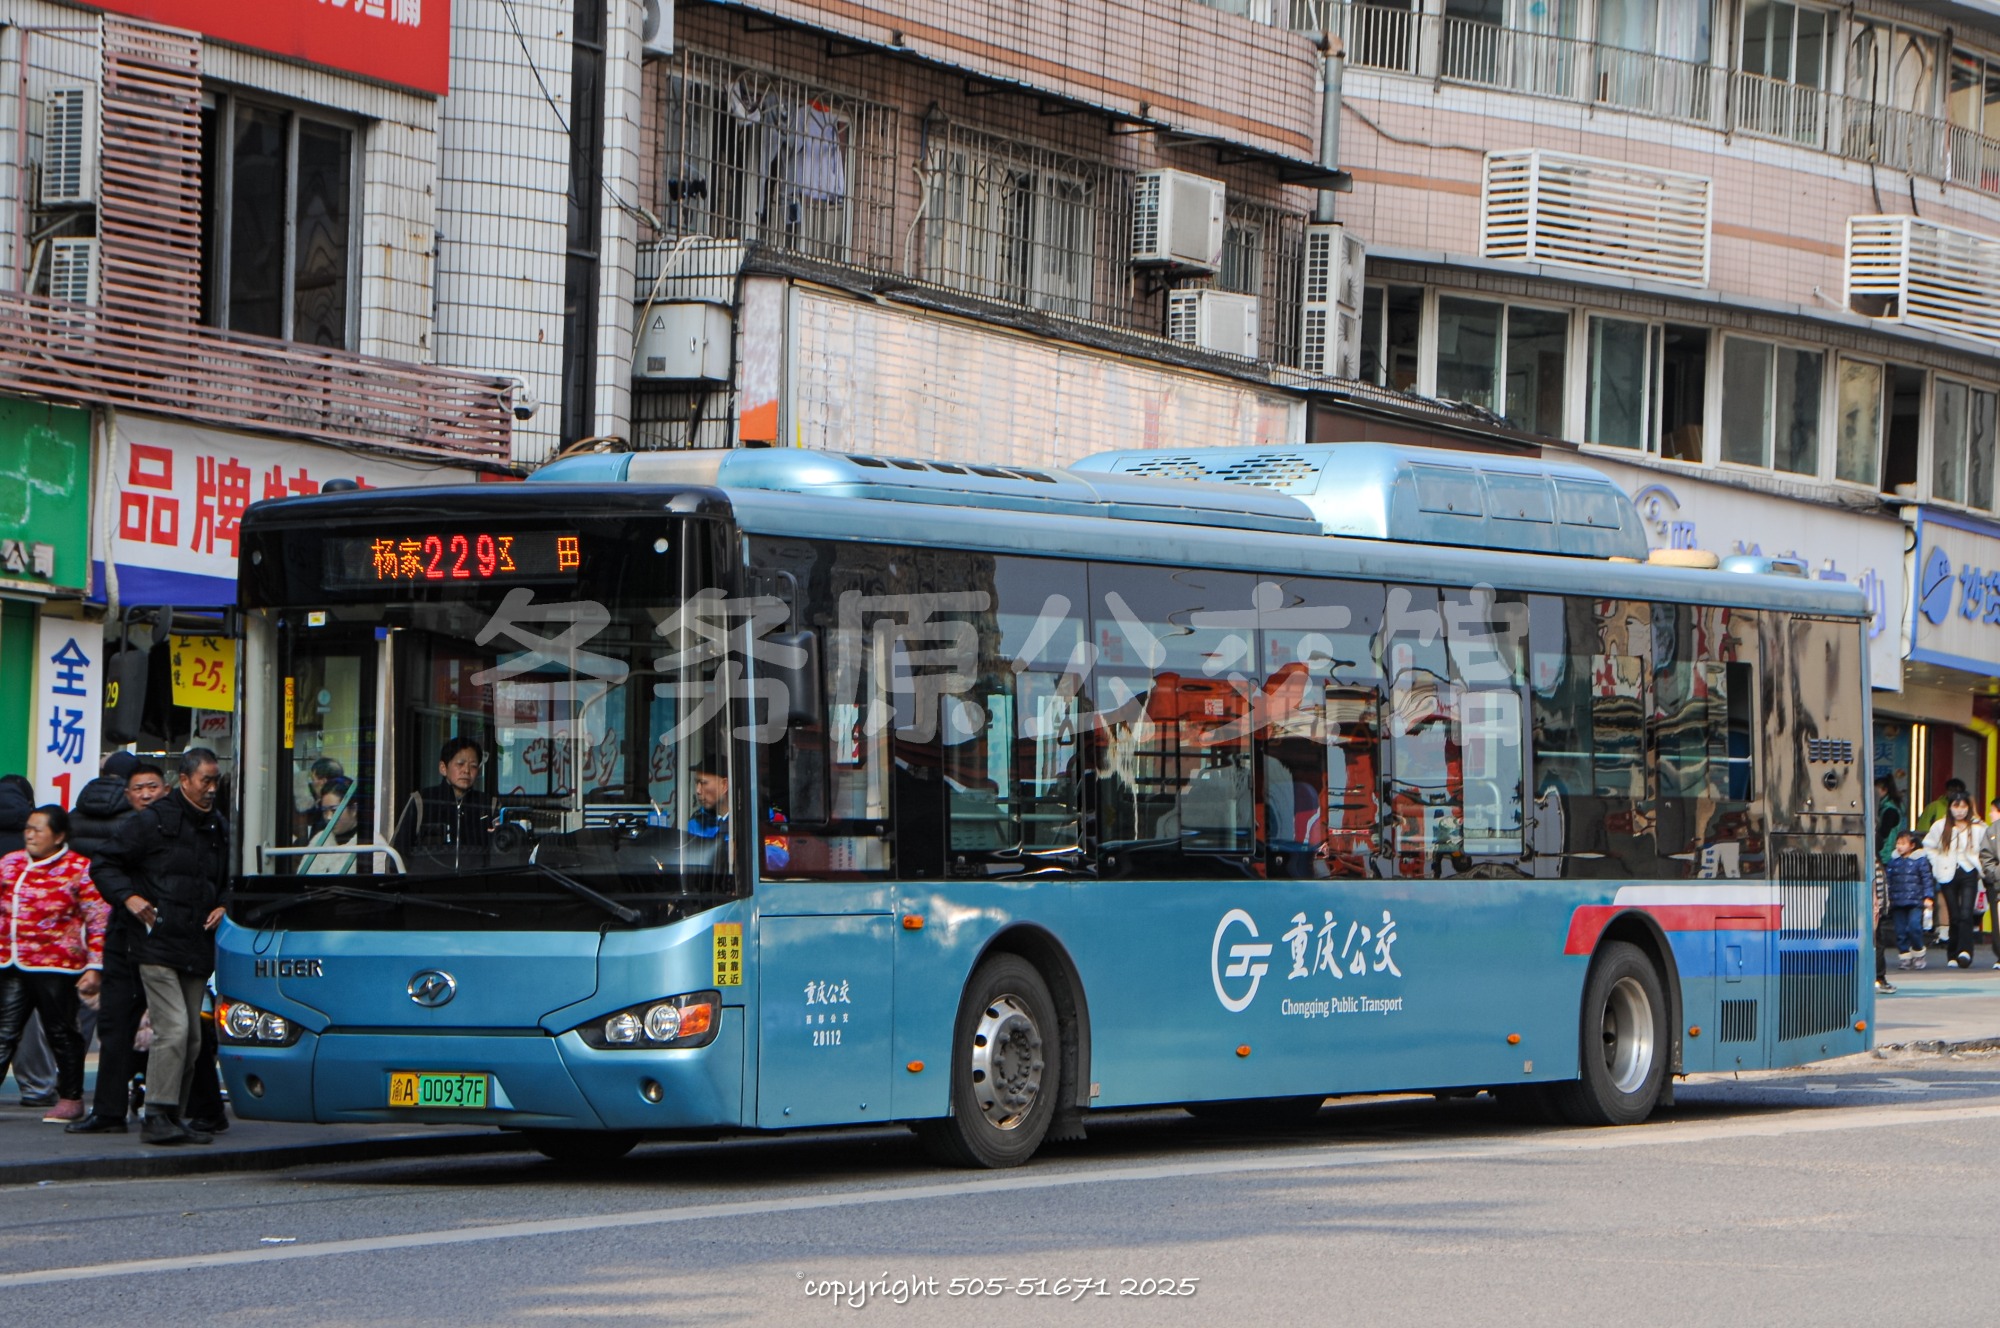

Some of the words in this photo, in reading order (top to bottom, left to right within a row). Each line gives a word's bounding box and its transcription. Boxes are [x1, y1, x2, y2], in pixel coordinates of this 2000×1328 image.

[119, 442, 378, 558] 品牌
[716, 935, 727, 985] 视线盲区
[730, 935, 740, 985] 请勿靠近
[1281, 910, 1402, 980] 重庆公交
[255, 959, 323, 978] HIGER
[803, 979, 851, 1006] 重庆公交
[1281, 998, 1330, 1019] Chongqing
[1331, 996, 1359, 1014] Public
[1360, 995, 1403, 1016] Transport
[812, 1029, 841, 1047] 20112
